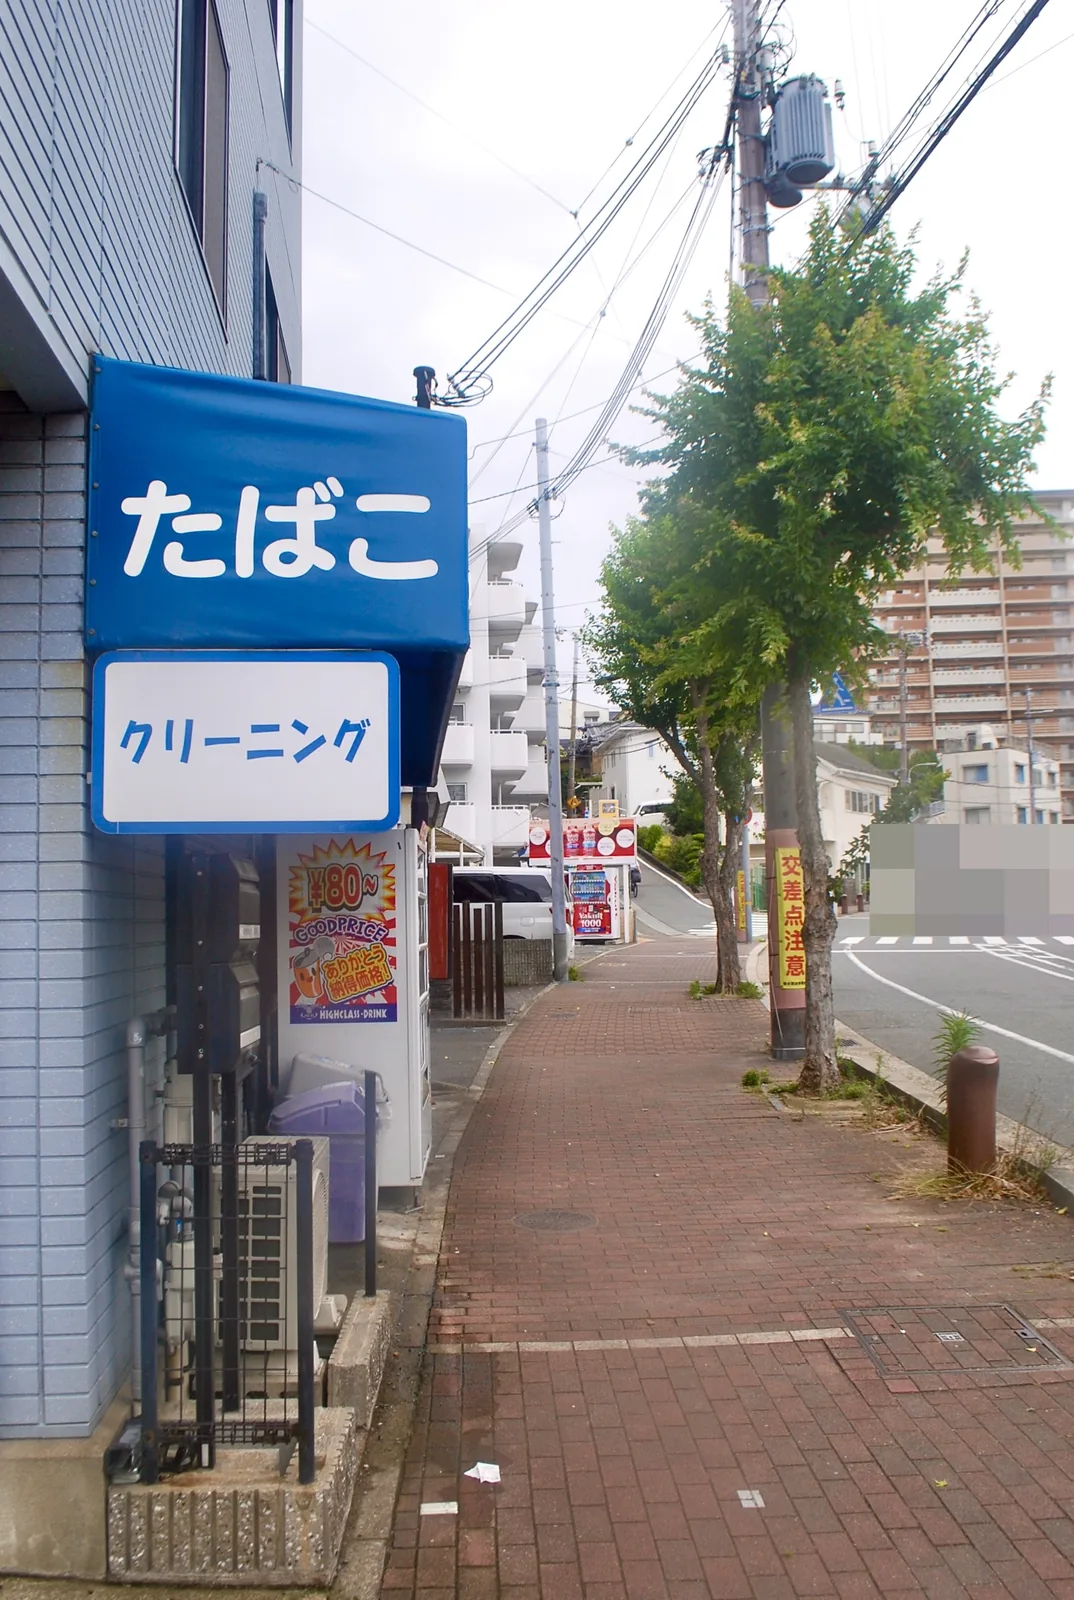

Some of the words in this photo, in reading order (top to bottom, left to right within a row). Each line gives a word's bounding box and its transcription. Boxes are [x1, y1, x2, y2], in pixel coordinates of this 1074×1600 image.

[121, 476, 439, 580] たばこ
[120, 718, 371, 764] クリーニング
[579, 912, 603, 920] Yakult
[580, 919, 602, 927] 1000
[782, 855, 804, 977] 交差点注意
[325, 945, 384, 979] ありがとう
